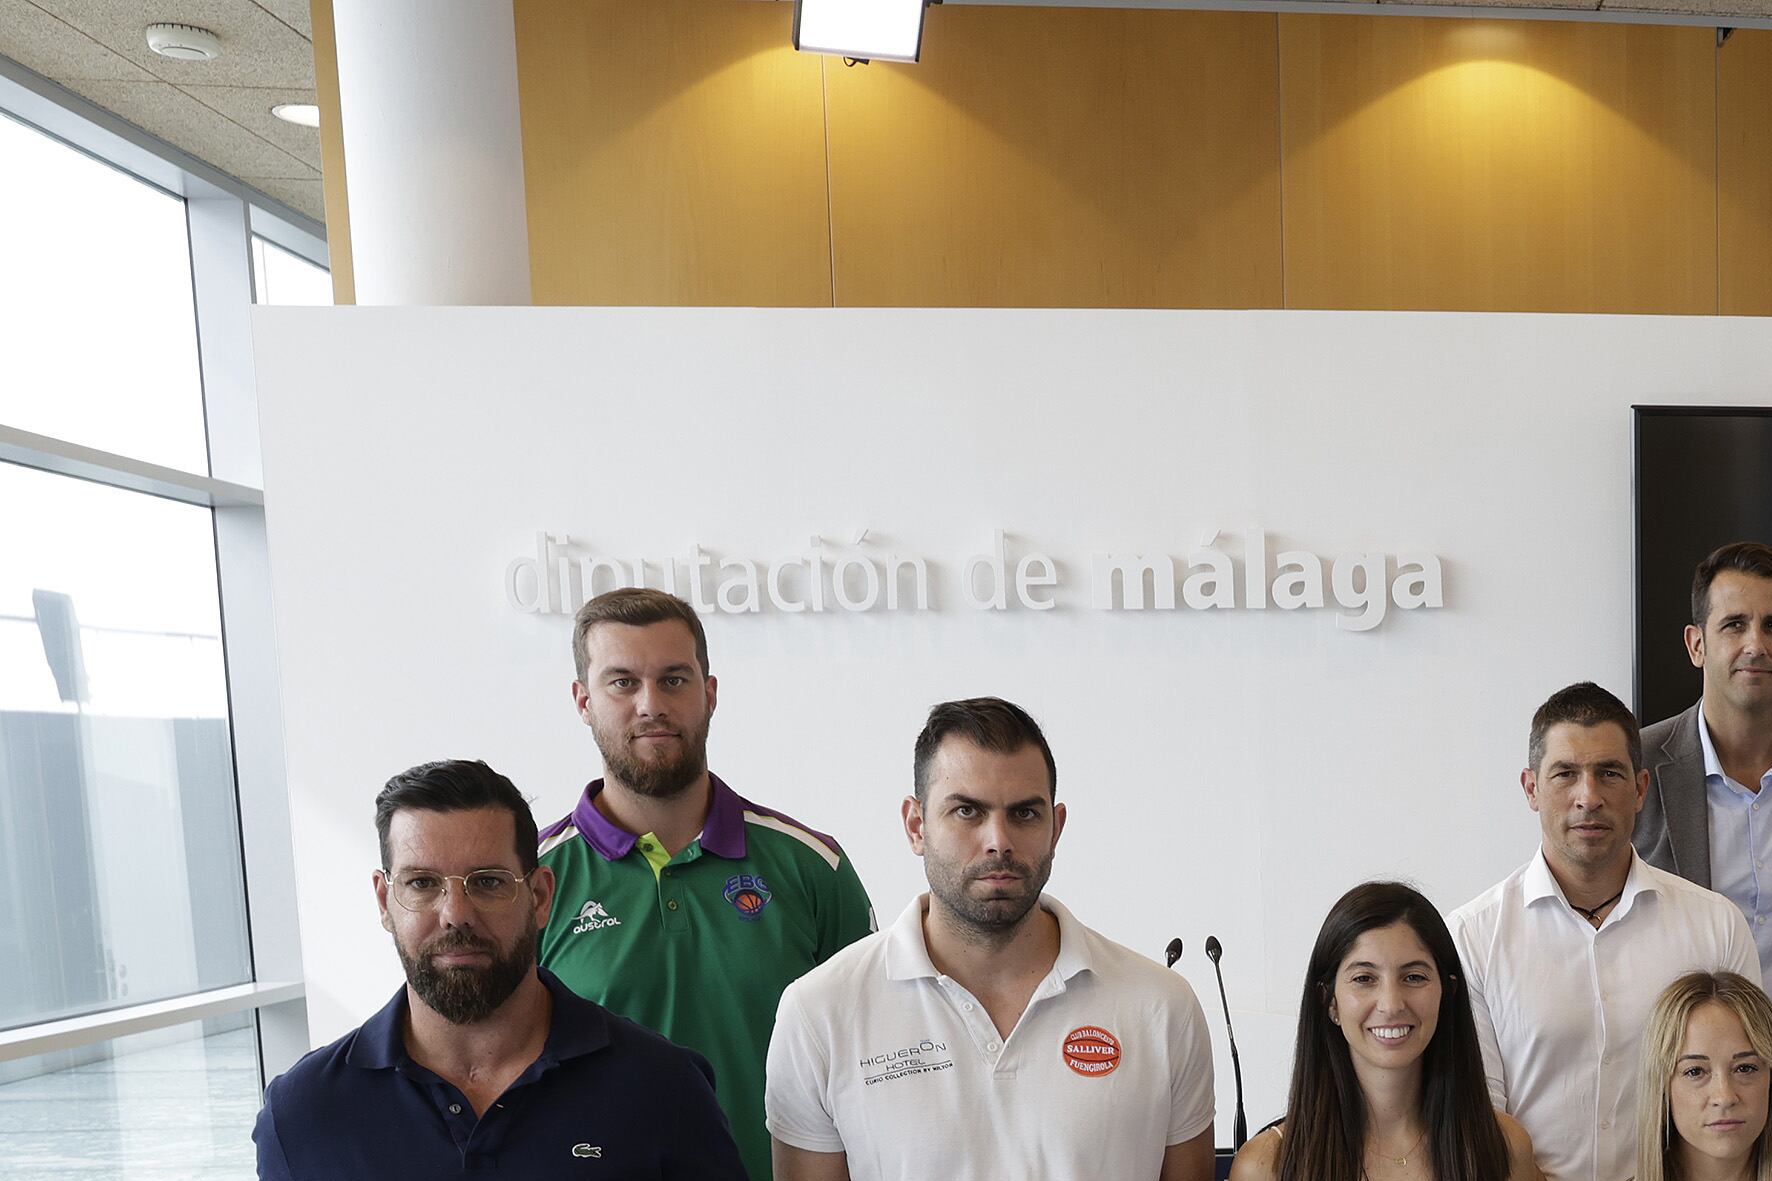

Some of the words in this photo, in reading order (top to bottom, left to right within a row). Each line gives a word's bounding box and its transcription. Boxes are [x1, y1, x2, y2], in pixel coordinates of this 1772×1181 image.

[962, 528, 1057, 611] de
[1092, 527, 1443, 632] málaga
[725, 874, 770, 892] EBC
[573, 917, 621, 935] austral
[1066, 1044, 1116, 1055] SALLIVER
[886, 1058, 926, 1071] HOTEL
[1069, 1059, 1114, 1072] FUENGIROLA
[865, 1076, 884, 1086] CURIO
[885, 1068, 922, 1081] COLLECTION
